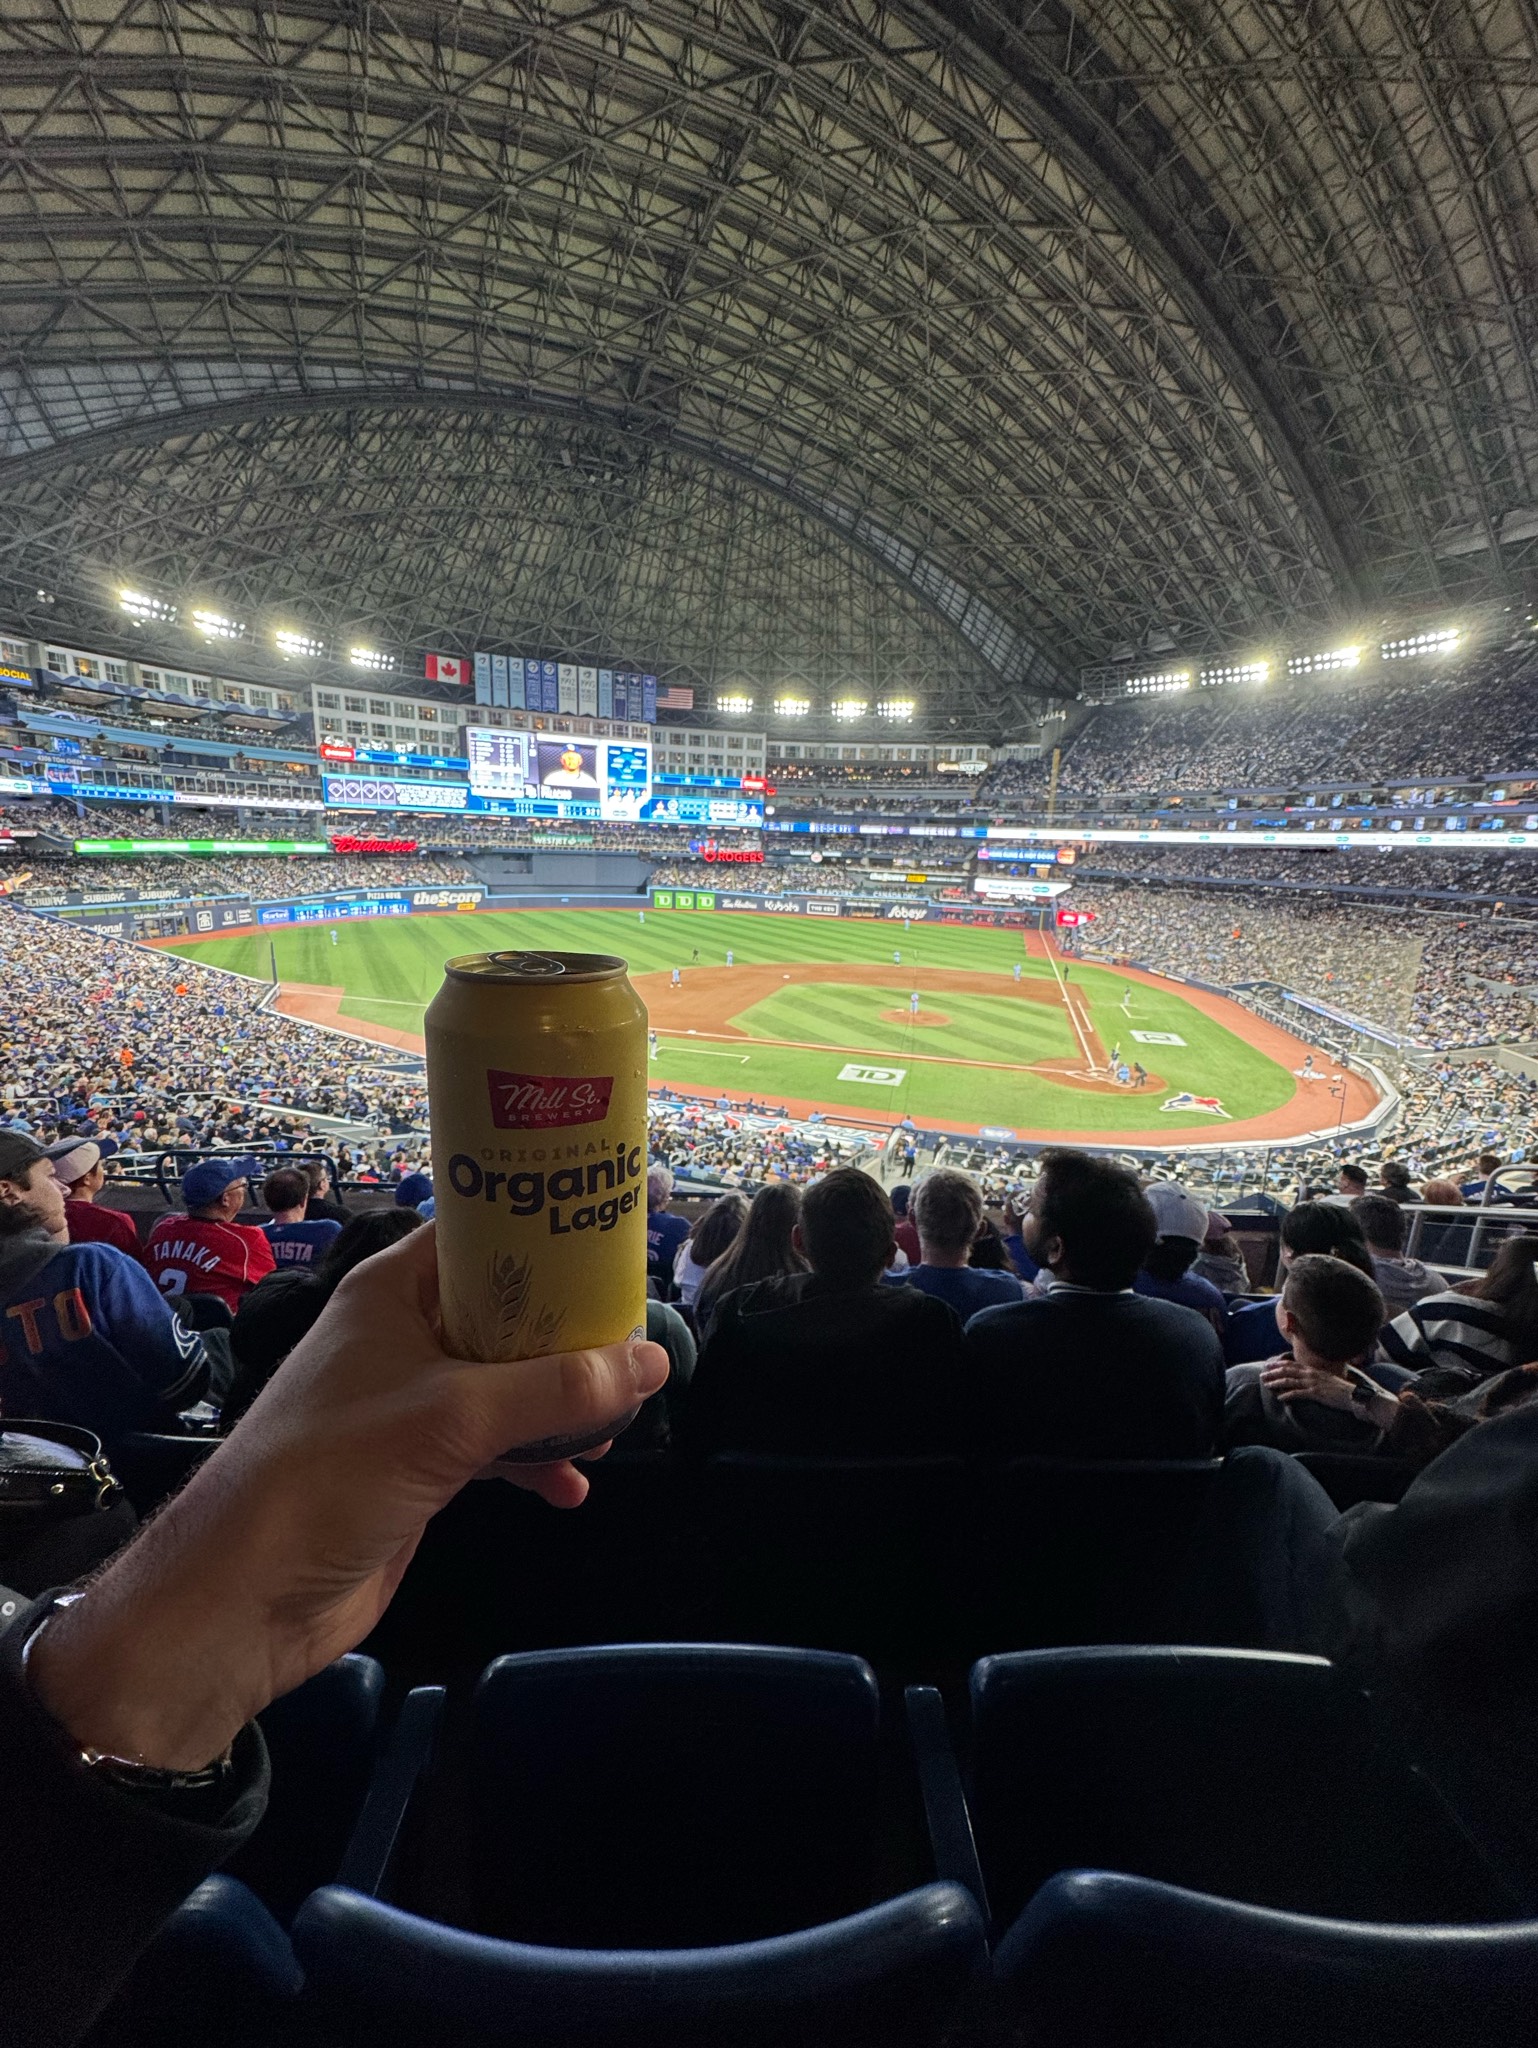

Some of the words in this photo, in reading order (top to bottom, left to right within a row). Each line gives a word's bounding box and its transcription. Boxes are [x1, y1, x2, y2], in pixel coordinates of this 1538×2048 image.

[331, 834, 418, 853] Budweiser
[717, 851, 764, 863] ROGERS
[82, 893, 124, 904] SUBWAY
[138, 890, 178, 900] SUBWAY
[413, 890, 481, 905] theScore
[658, 895, 671, 906] TD
[679, 896, 692, 906] TD
[700, 897, 713, 907] TD
[765, 900, 799, 912] Kubota
[888, 905, 927, 920] Sobeys
[498, 1083, 568, 1110] Mill
[570, 1083, 600, 1109] St.
[508, 1107, 593, 1122] BREWERY
[481, 1138, 611, 1162] ORIGINAL
[448, 1142, 641, 1216] Organic
[550, 1183, 642, 1235] Lager
[153, 1240, 221, 1273] TANAKA
